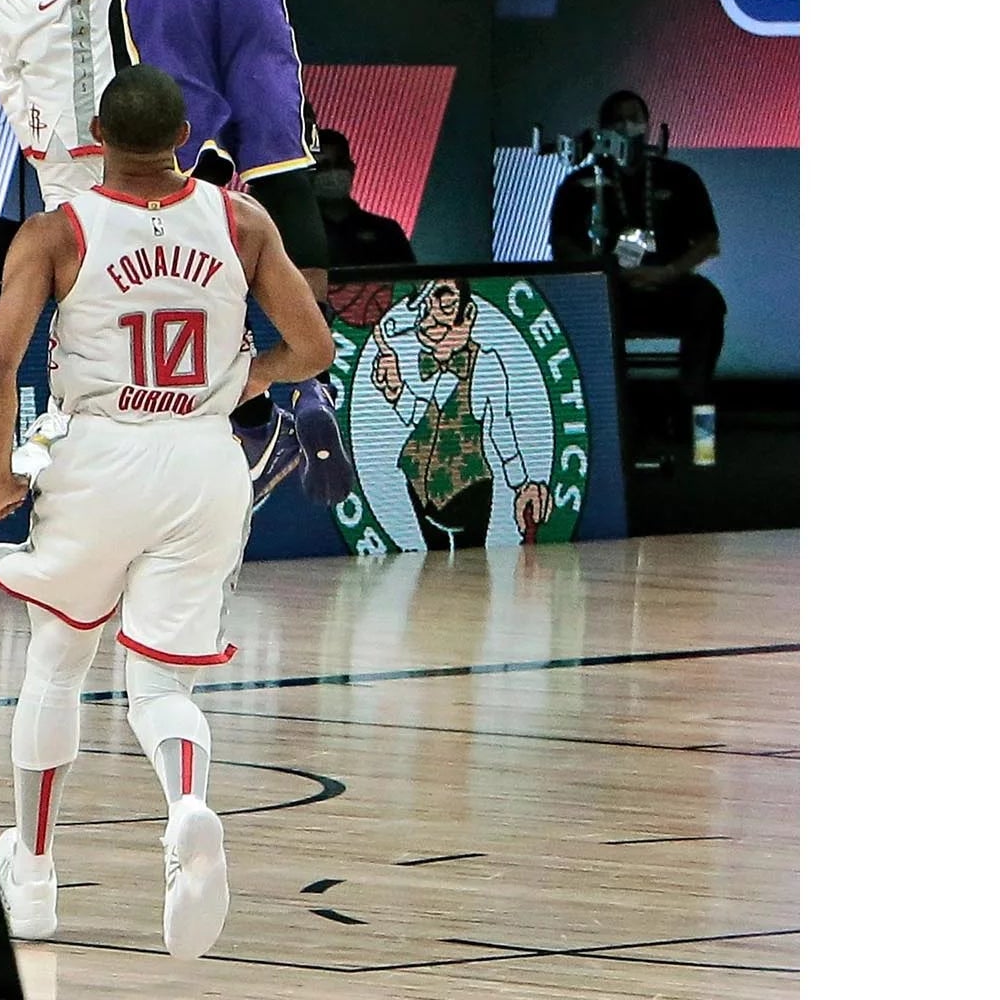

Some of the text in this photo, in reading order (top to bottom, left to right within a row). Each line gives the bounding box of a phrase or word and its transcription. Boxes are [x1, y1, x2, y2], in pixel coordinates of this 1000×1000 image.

[106, 245, 224, 294] EQUALITY
[117, 308, 209, 388] 10
[507, 280, 588, 513] CELTICS
